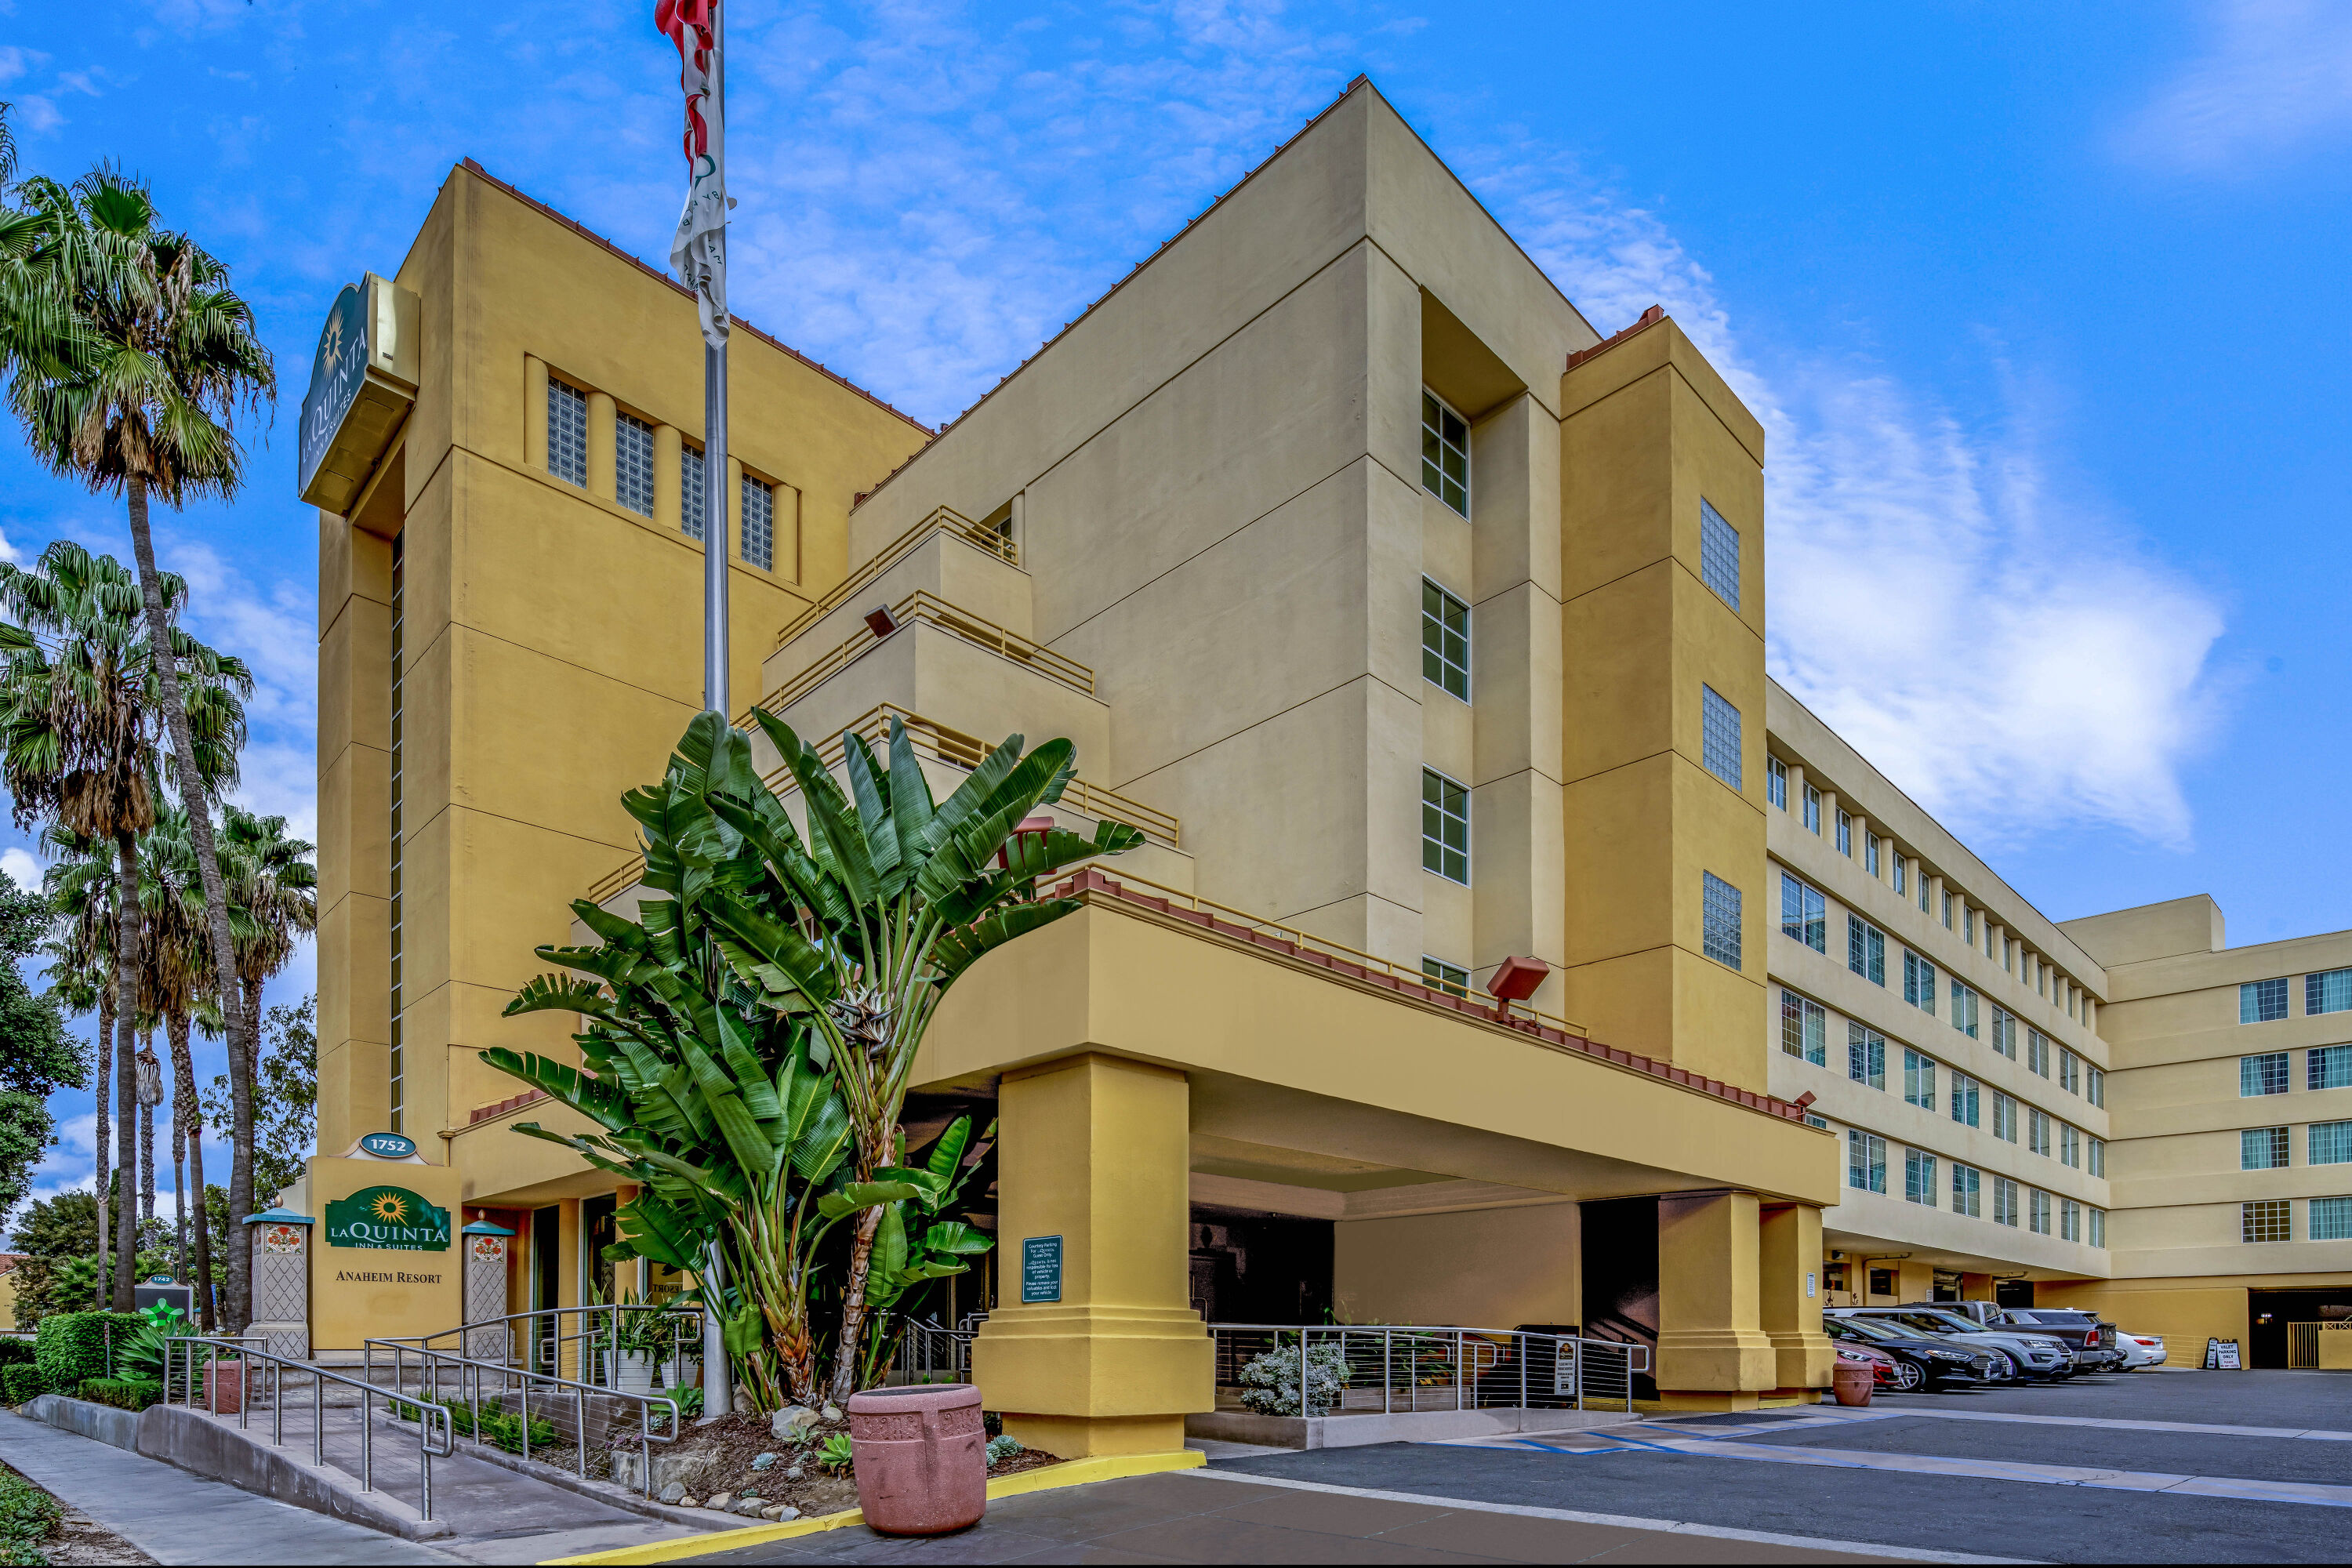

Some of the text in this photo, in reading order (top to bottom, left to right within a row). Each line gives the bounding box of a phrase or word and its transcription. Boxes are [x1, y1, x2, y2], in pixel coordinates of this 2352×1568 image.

[312, 326, 367, 443] QUINTA
[314, 442, 324, 464] INN
[329, 388, 351, 434] SUITES
[371, 1138, 406, 1152] 1752
[350, 1222, 448, 1243] QUINTA
[336, 1270, 441, 1284] ANAHEIM RESORT
